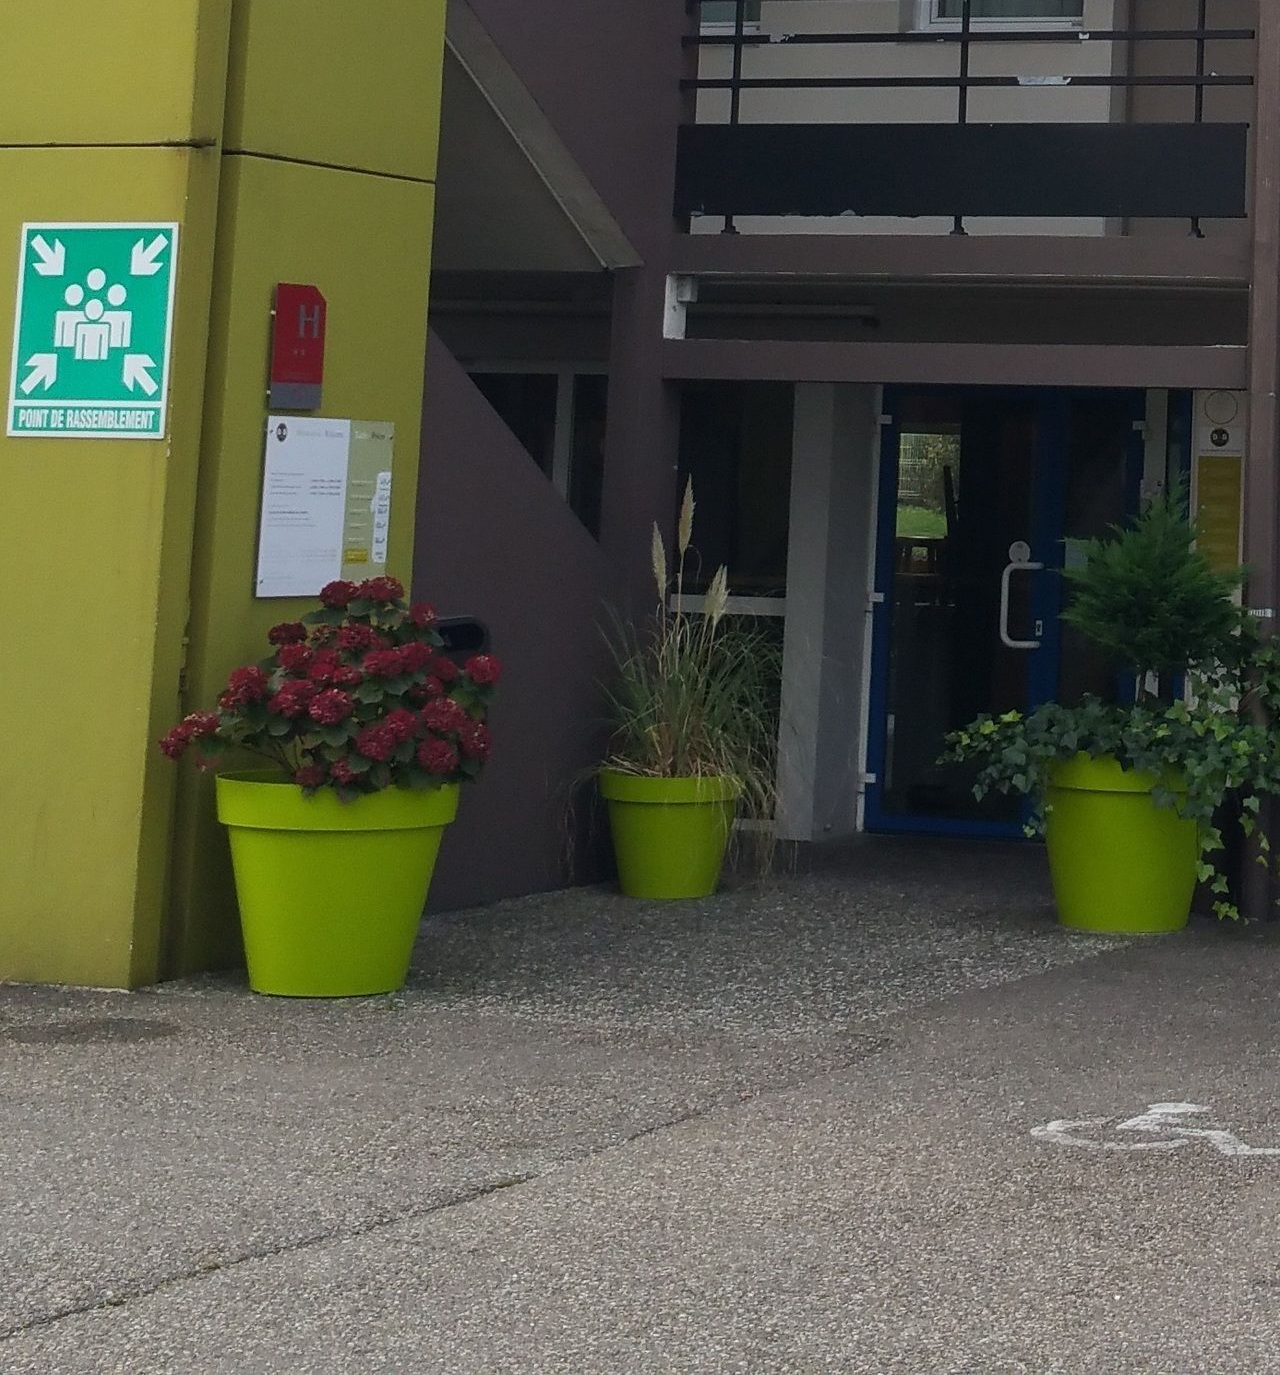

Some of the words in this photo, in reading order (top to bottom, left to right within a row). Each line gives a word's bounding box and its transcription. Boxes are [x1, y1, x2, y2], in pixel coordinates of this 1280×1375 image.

[19, 408, 49, 428] POINT
[50, 409, 65, 428] DE
[66, 409, 156, 430] RASSEMBLEMENT
